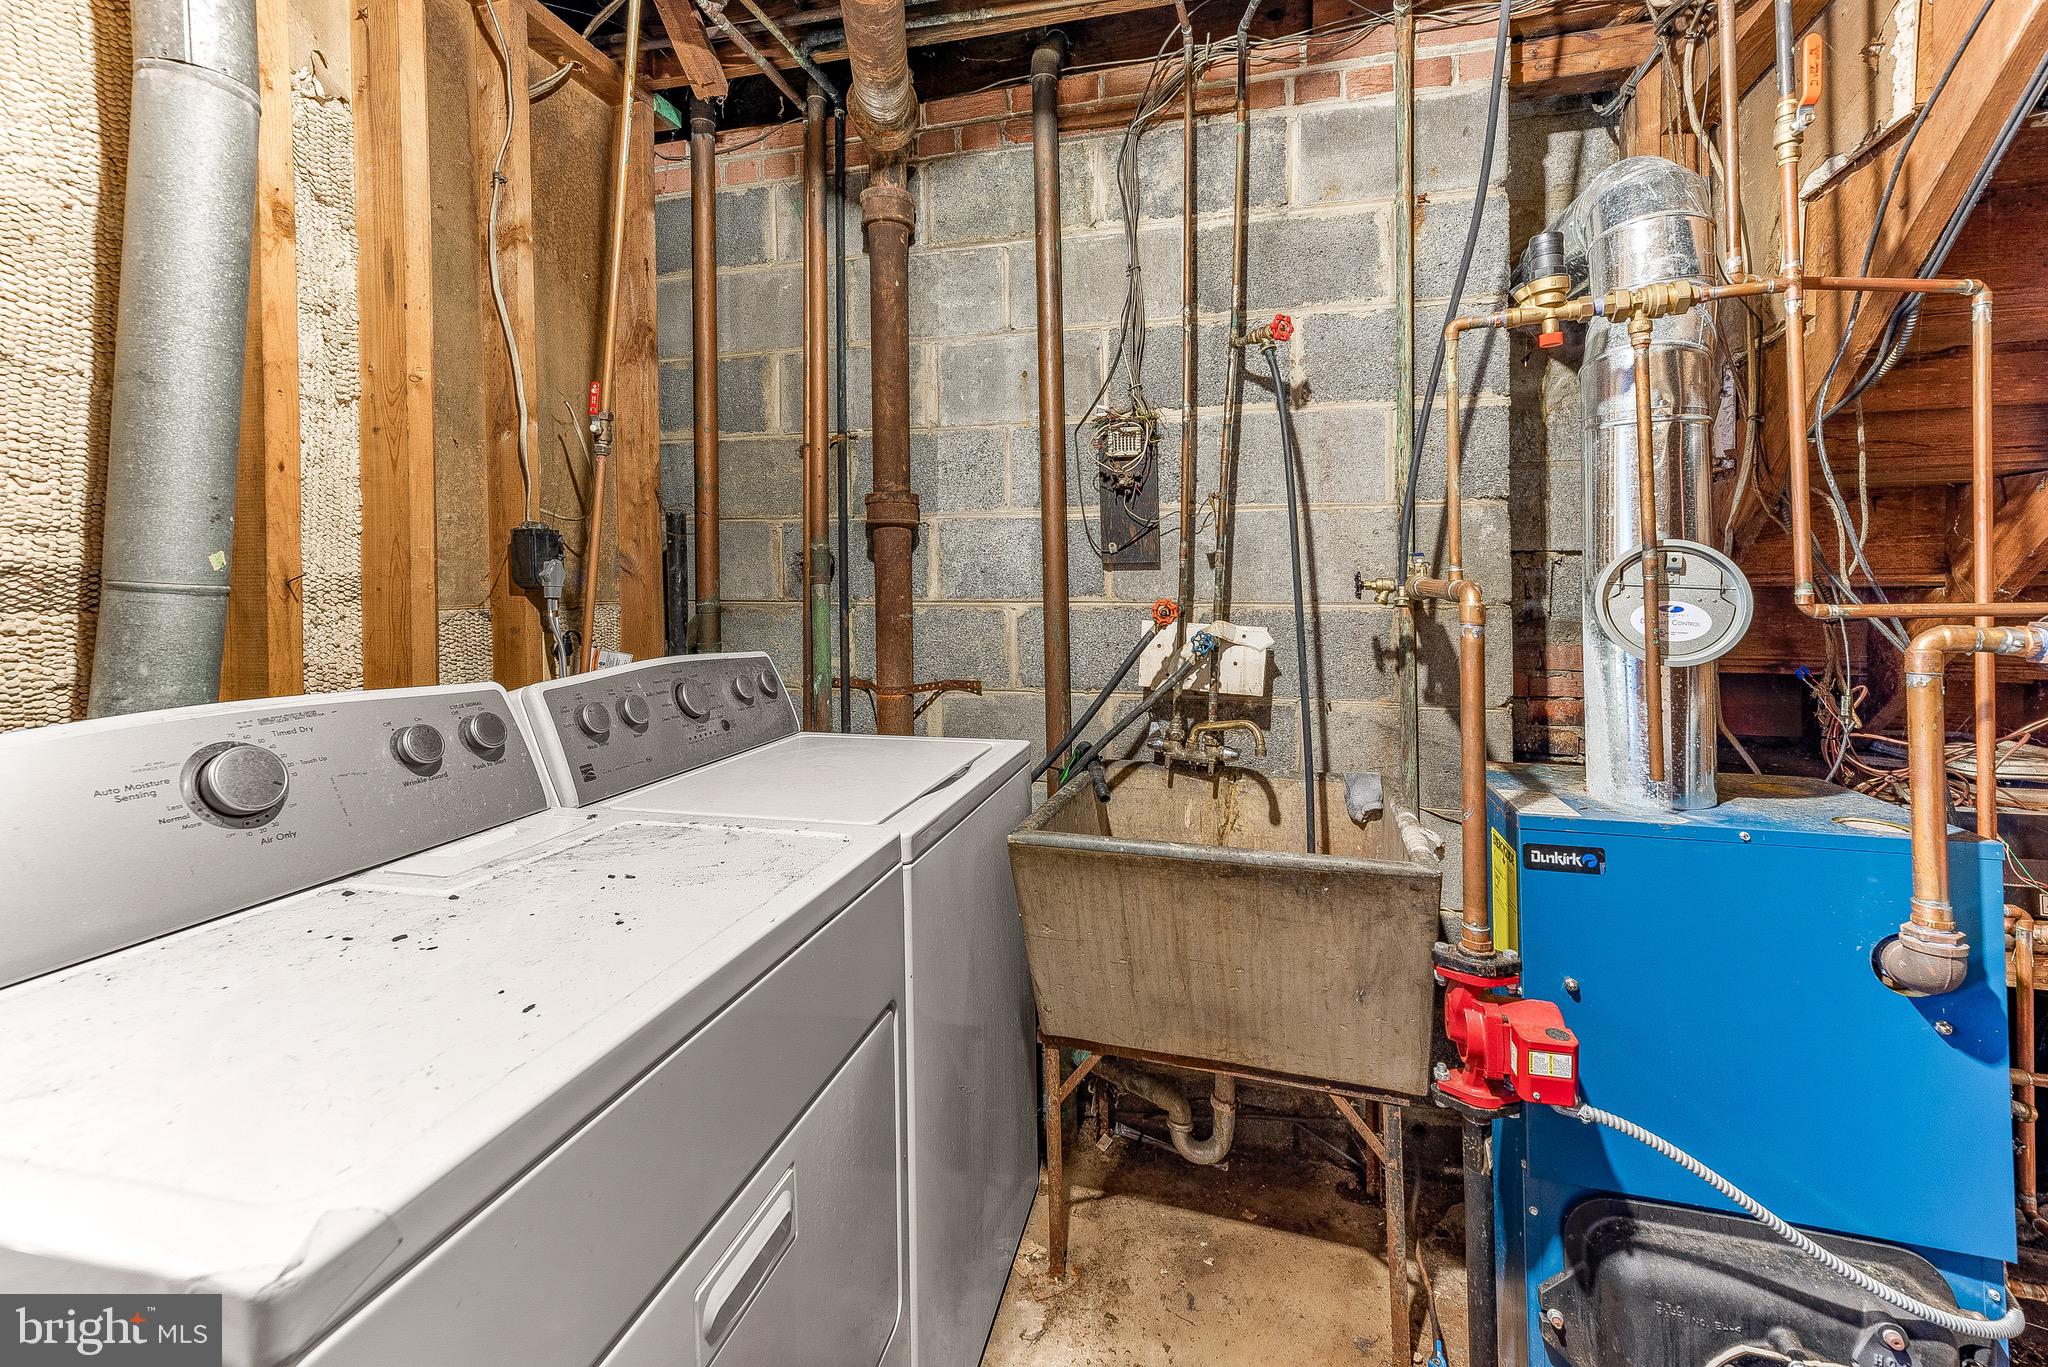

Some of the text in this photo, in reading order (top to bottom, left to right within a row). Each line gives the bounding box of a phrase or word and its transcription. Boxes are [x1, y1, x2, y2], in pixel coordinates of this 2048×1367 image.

[1671, 618, 1701, 628] CONTROL
[271, 724, 315, 738] Timed Dry
[300, 758, 318, 766] Touch
[318, 755, 328, 764] Up
[472, 763, 487, 771] Push
[402, 771, 449, 787] Wrinkle Guard
[93, 777, 170, 798] Auto Moisture
[114, 789, 158, 804] Sensing
[166, 803, 184, 812] Less
[158, 812, 191, 825] Normal
[181, 821, 203, 831] More
[260, 830, 298, 846] Air Only
[1530, 849, 1584, 868] Dunkirk
